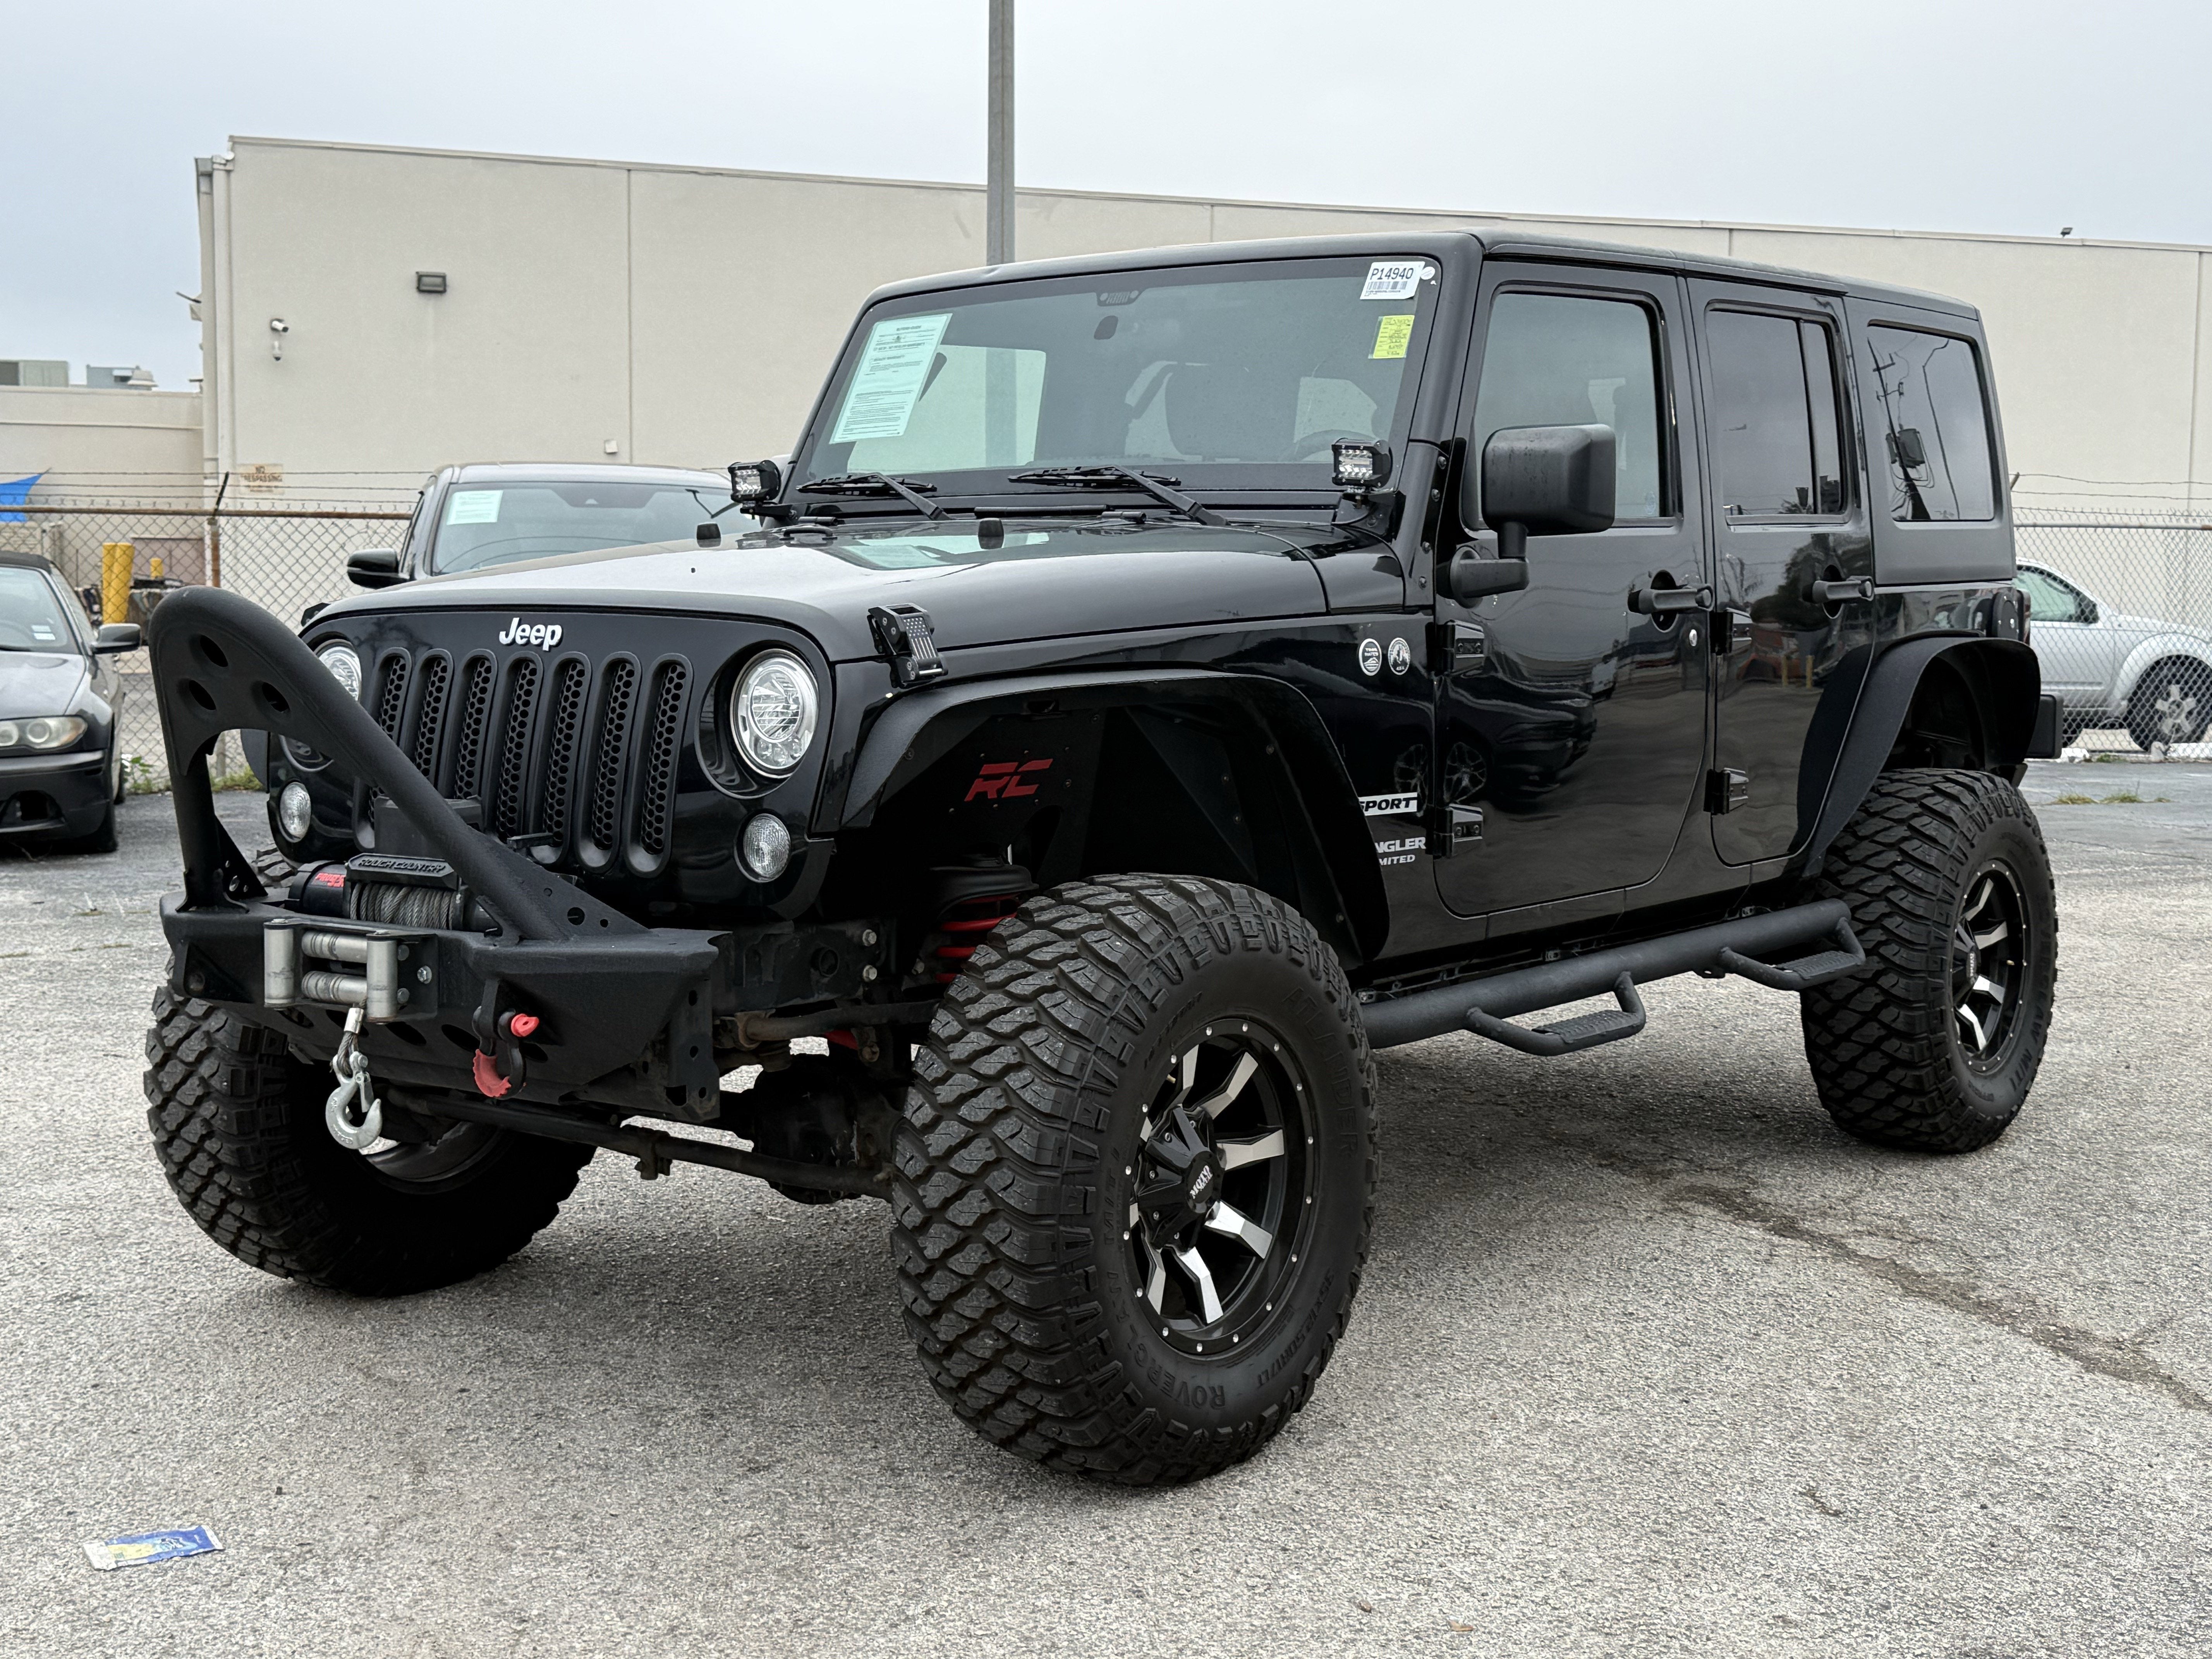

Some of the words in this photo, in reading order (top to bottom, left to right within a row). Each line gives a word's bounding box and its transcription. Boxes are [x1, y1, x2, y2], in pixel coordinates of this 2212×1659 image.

[1370, 267, 1414, 280] P14940
[499, 617, 562, 651] Jeep
[964, 758, 1053, 802] RC
[1375, 836, 1427, 853] NGLER
[1379, 854, 1415, 866] MITED
